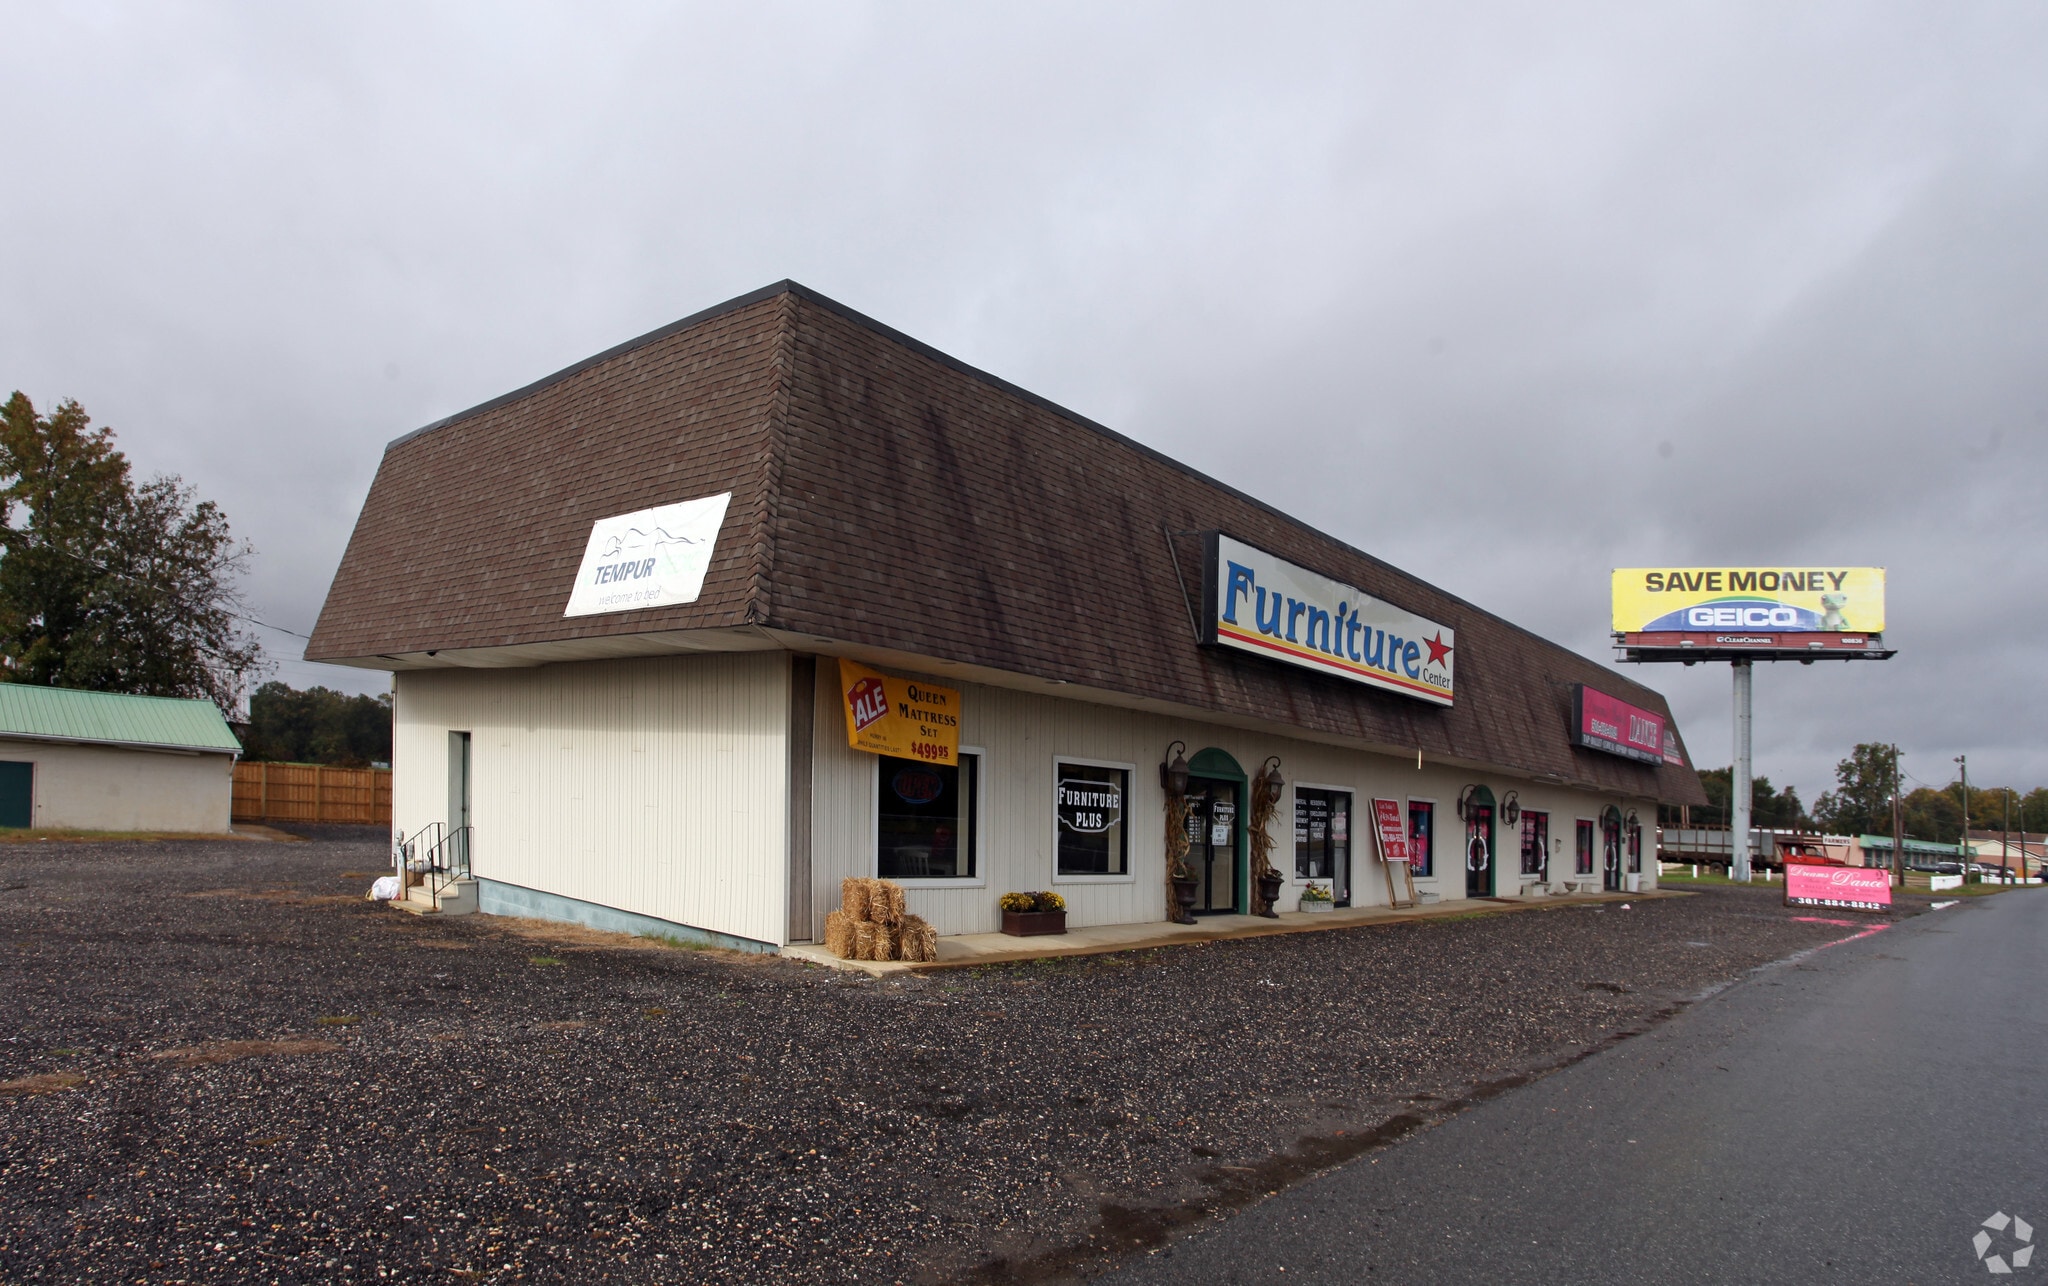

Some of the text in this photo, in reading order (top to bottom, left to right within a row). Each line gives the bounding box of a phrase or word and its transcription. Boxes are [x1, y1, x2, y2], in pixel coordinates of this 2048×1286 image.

[594, 557, 656, 585] TEMPUR
[1645, 571, 1848, 592] SAVE MONEY
[599, 586, 662, 605] welcome to bed
[1222, 560, 1421, 680] Furniture
[1688, 607, 1797, 627] GEICO
[1422, 668, 1451, 689] Center
[1076, 812, 1102, 828] PLUS
[1790, 866, 1829, 878] Dreams
[1830, 870, 1886, 888] Dance
